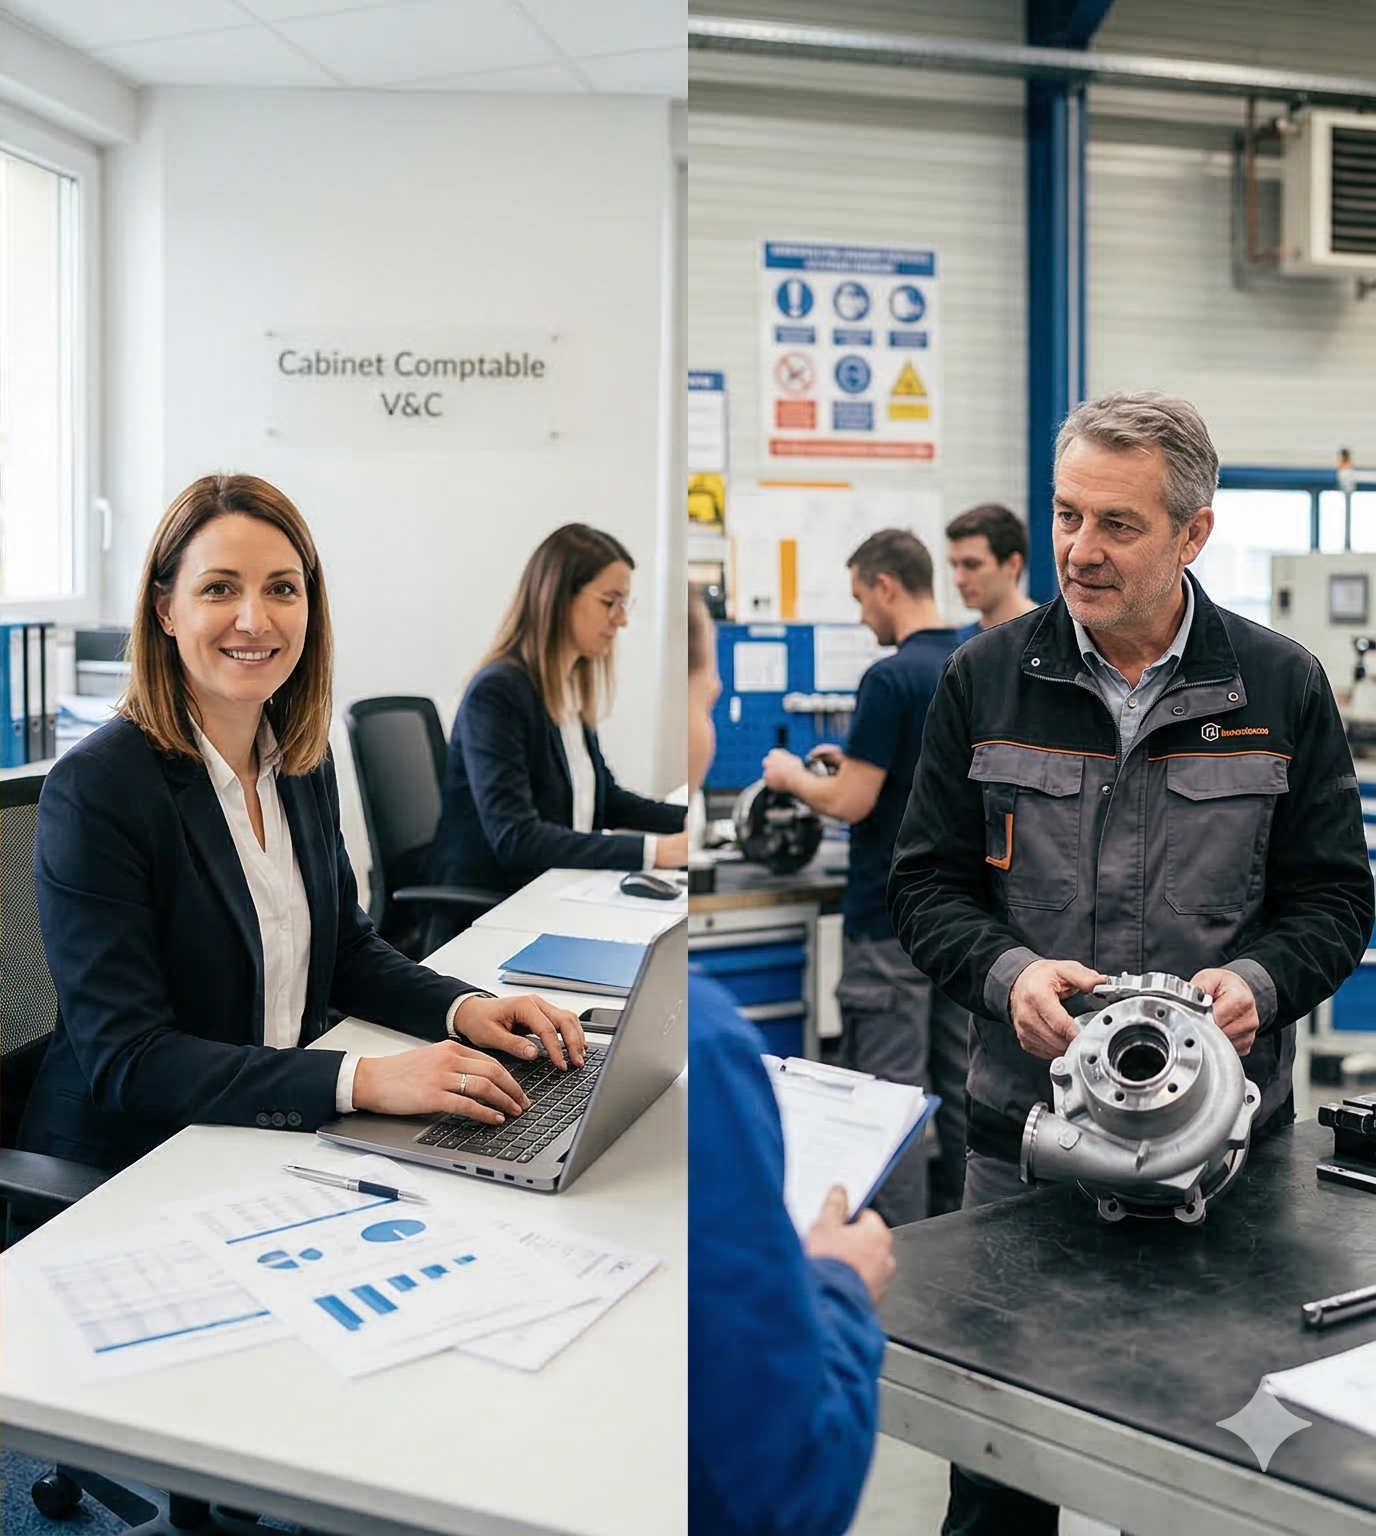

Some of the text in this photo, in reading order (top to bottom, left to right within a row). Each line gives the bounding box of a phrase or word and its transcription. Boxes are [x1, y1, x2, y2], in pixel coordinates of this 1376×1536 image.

[277, 349, 546, 381] Cabinet Comptable
[380, 391, 444, 418] V&C
